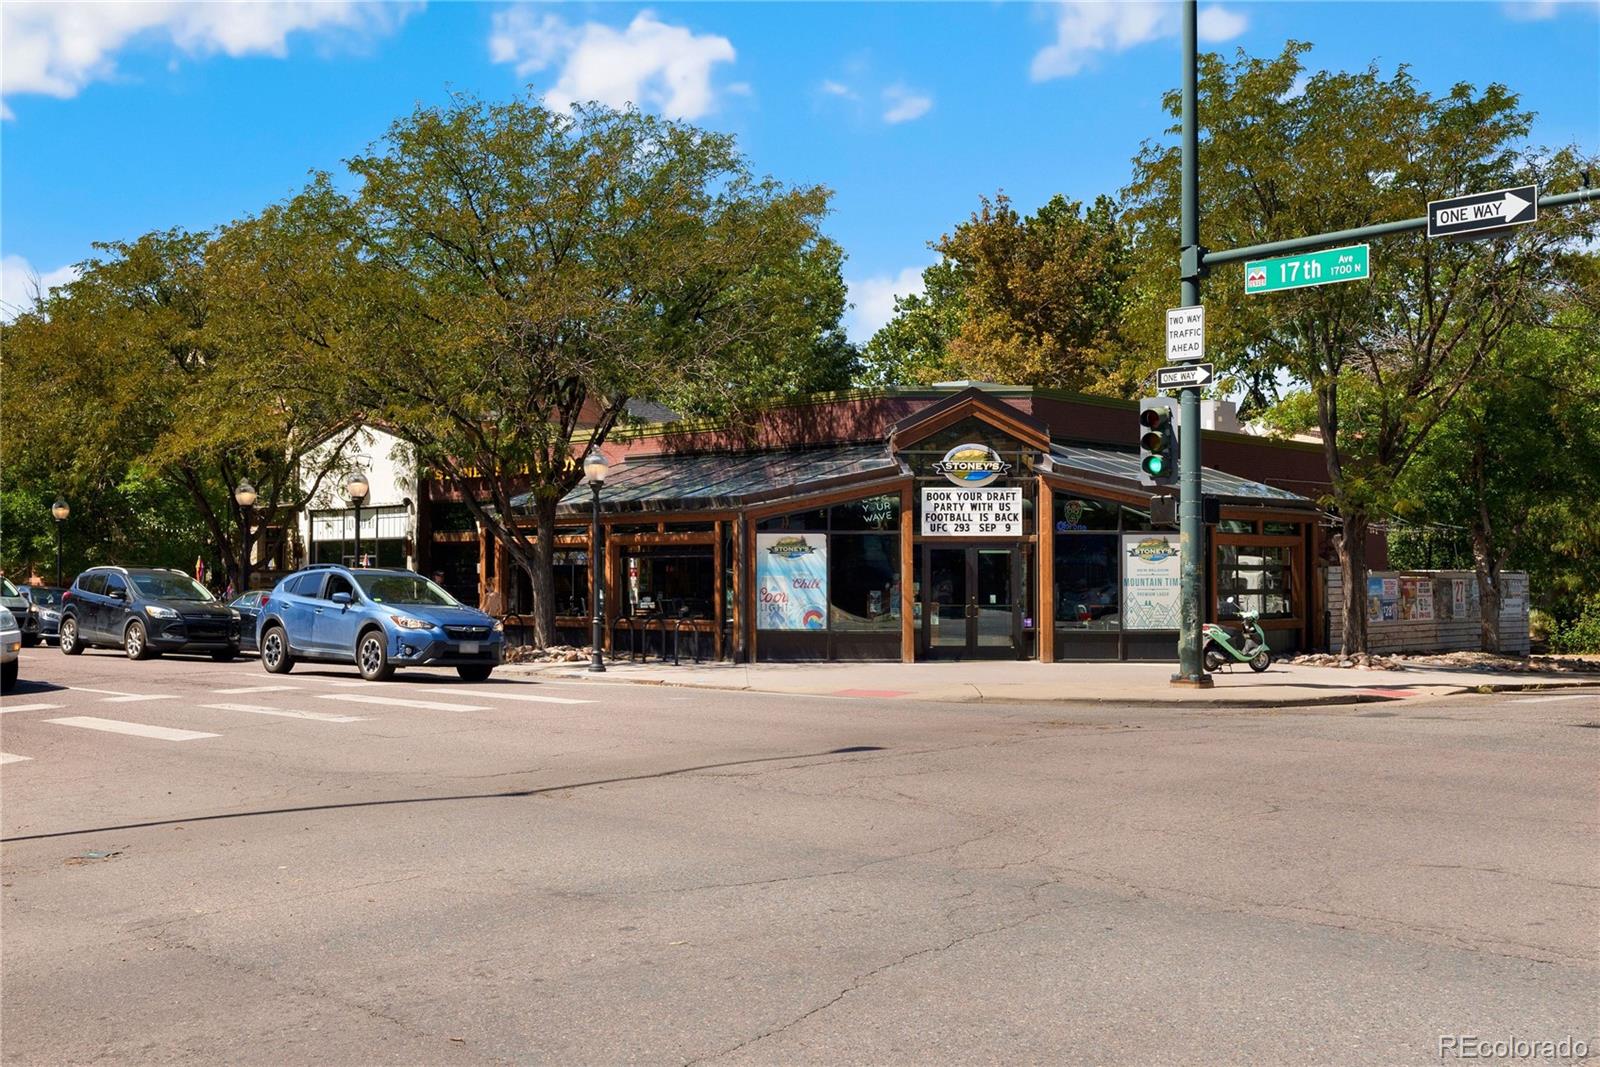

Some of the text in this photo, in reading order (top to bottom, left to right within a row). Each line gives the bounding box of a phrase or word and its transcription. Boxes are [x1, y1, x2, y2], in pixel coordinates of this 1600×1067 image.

[1440, 202, 1502, 224] ONE WAY
[1338, 255, 1354, 264] Ave
[1280, 259, 1322, 283] 17th
[1330, 263, 1361, 276] 1700 N
[1169, 314, 1202, 326] TWO WAY
[1169, 328, 1202, 339] TRAFFIC
[1171, 342, 1200, 353] AHEAD
[1163, 371, 1196, 383] ONE WAY
[945, 462, 1000, 471] STONEY'S
[926, 492, 1017, 501] BOOK YOUR DRAFT
[933, 502, 1011, 511] PARTY WITH US
[863, 511, 892, 522] WAVE
[925, 513, 1019, 522] FOOTBALL IS BACK
[929, 523, 1011, 532] UFC 293 SEP 9
[1135, 547, 1172, 555] STONEY'S
[1124, 577, 1162, 587] MOUNTAIN
[1164, 577, 1181, 587] TIM
